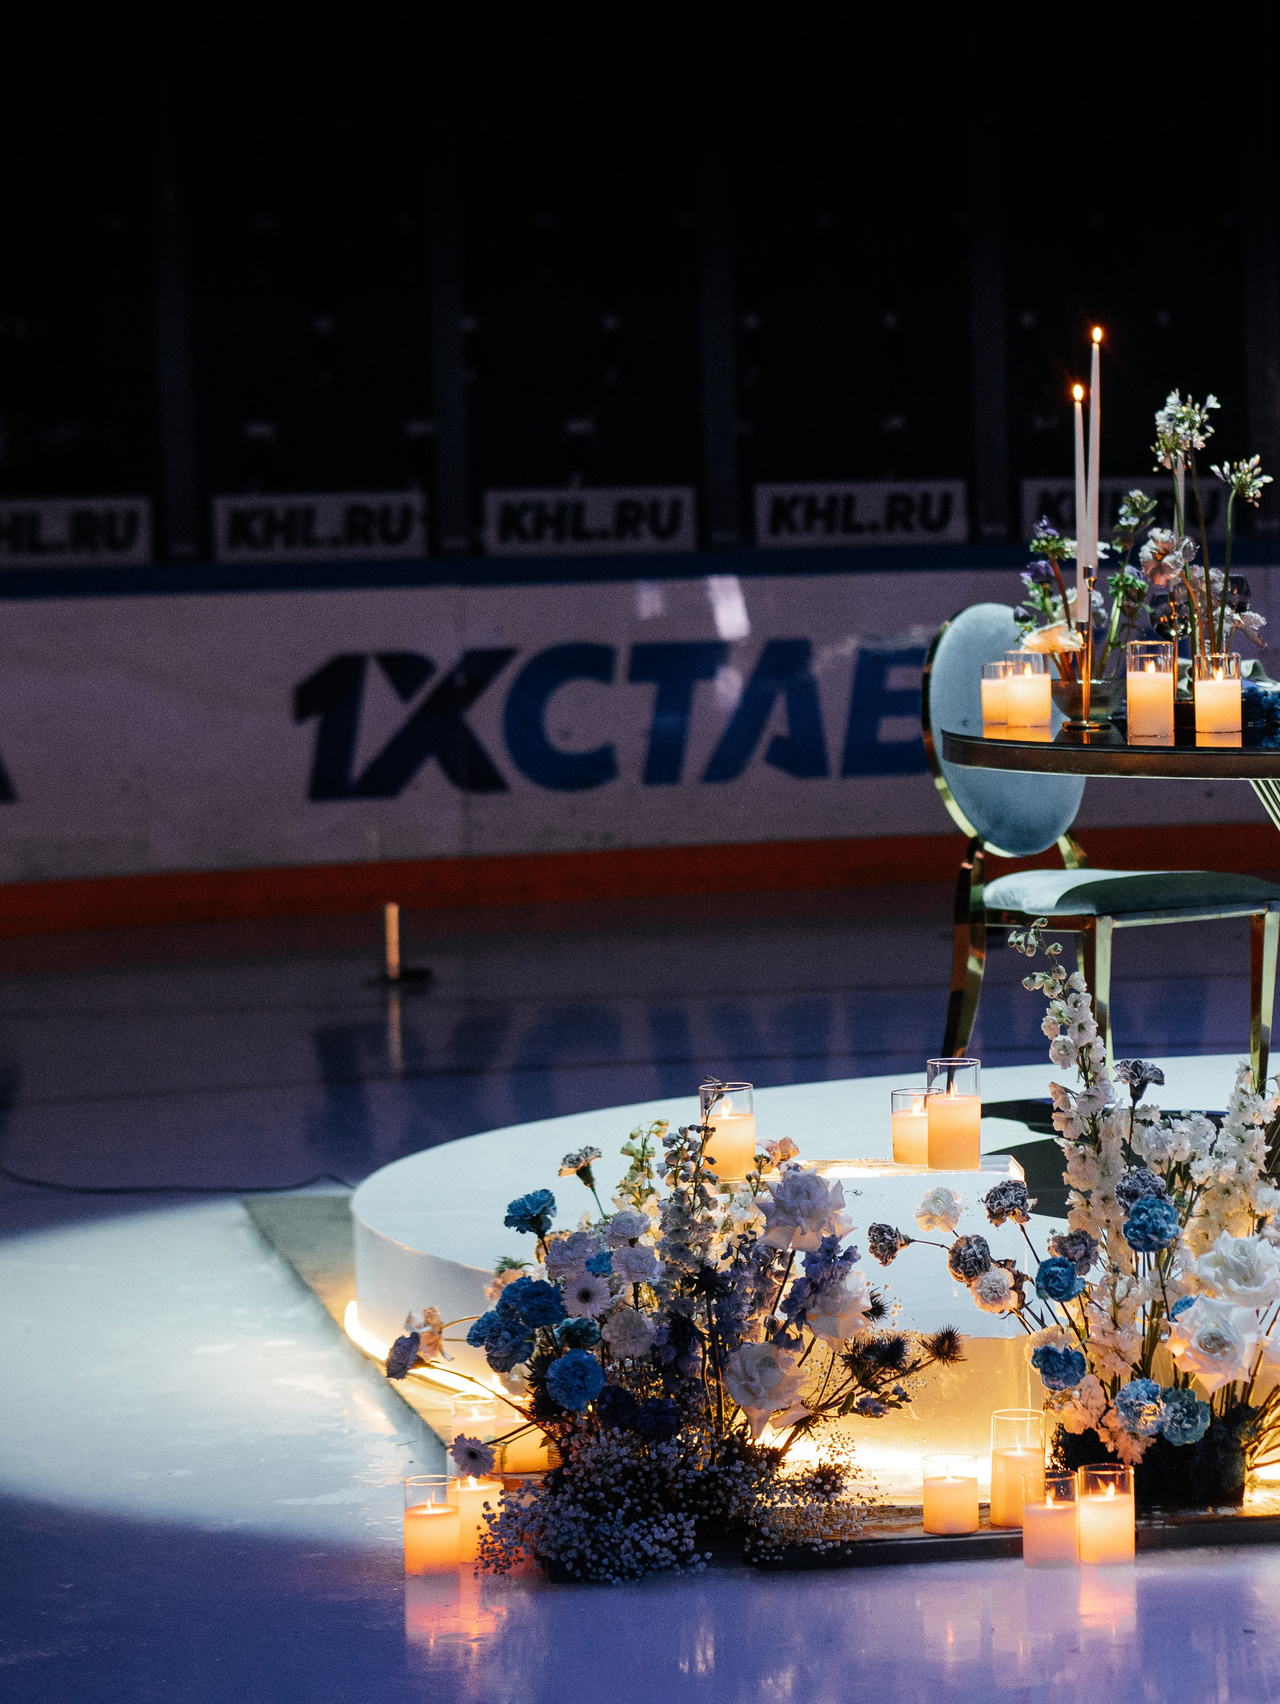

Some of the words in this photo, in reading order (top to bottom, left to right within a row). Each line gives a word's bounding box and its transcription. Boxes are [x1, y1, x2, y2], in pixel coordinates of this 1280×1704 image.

[0, 510, 138, 553] HL.RU
[228, 505, 413, 549] KHL.RU
[500, 498, 682, 544] KHL.RU
[769, 493, 954, 537] KHL.RU
